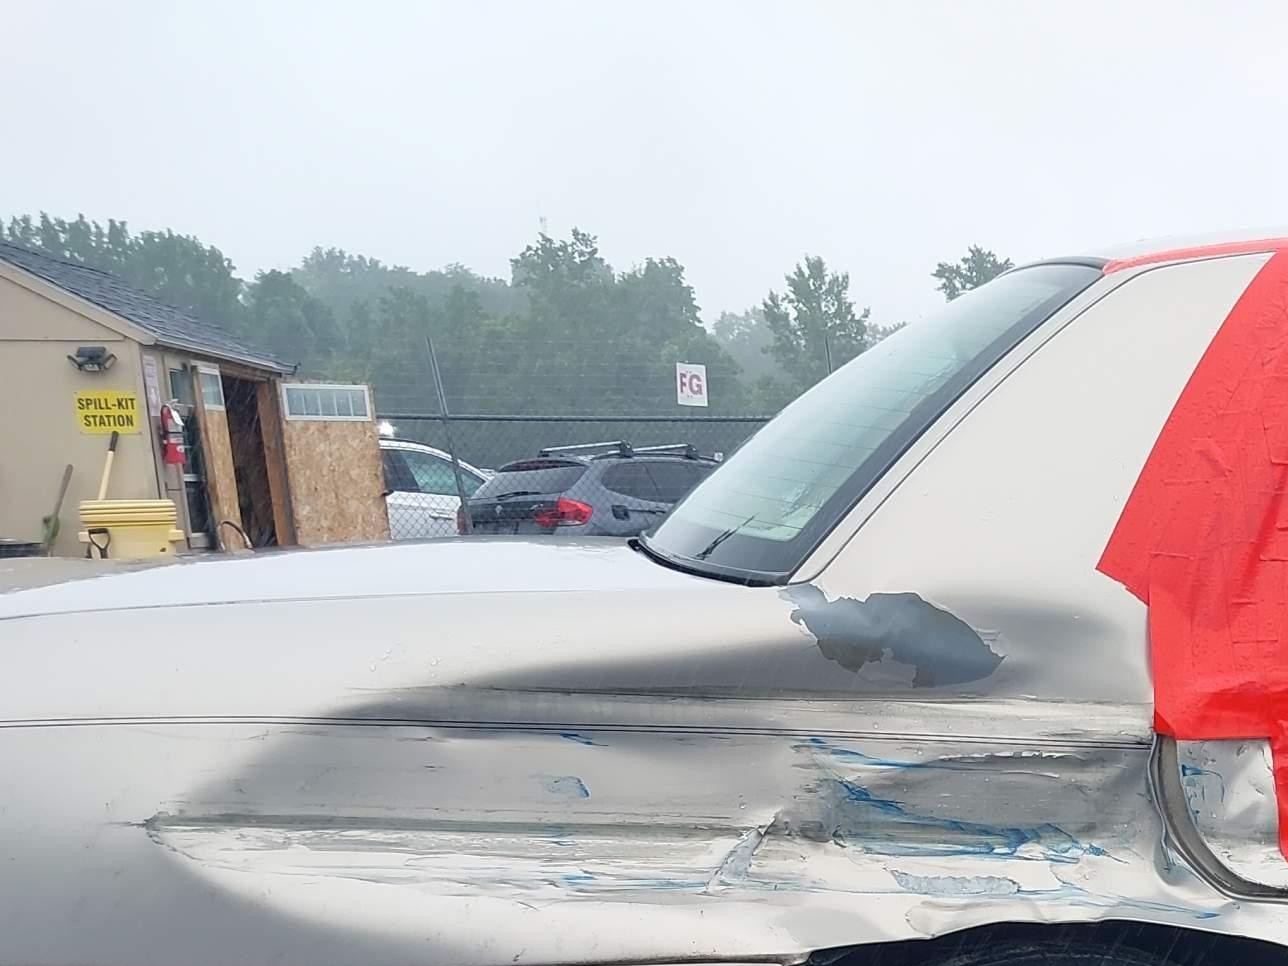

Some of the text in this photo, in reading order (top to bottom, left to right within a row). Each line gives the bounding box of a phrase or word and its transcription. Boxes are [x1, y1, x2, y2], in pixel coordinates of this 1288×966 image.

[679, 372, 703, 396] FG
[77, 398, 136, 410] SPILL-KIT
[83, 414, 134, 427] STATION
